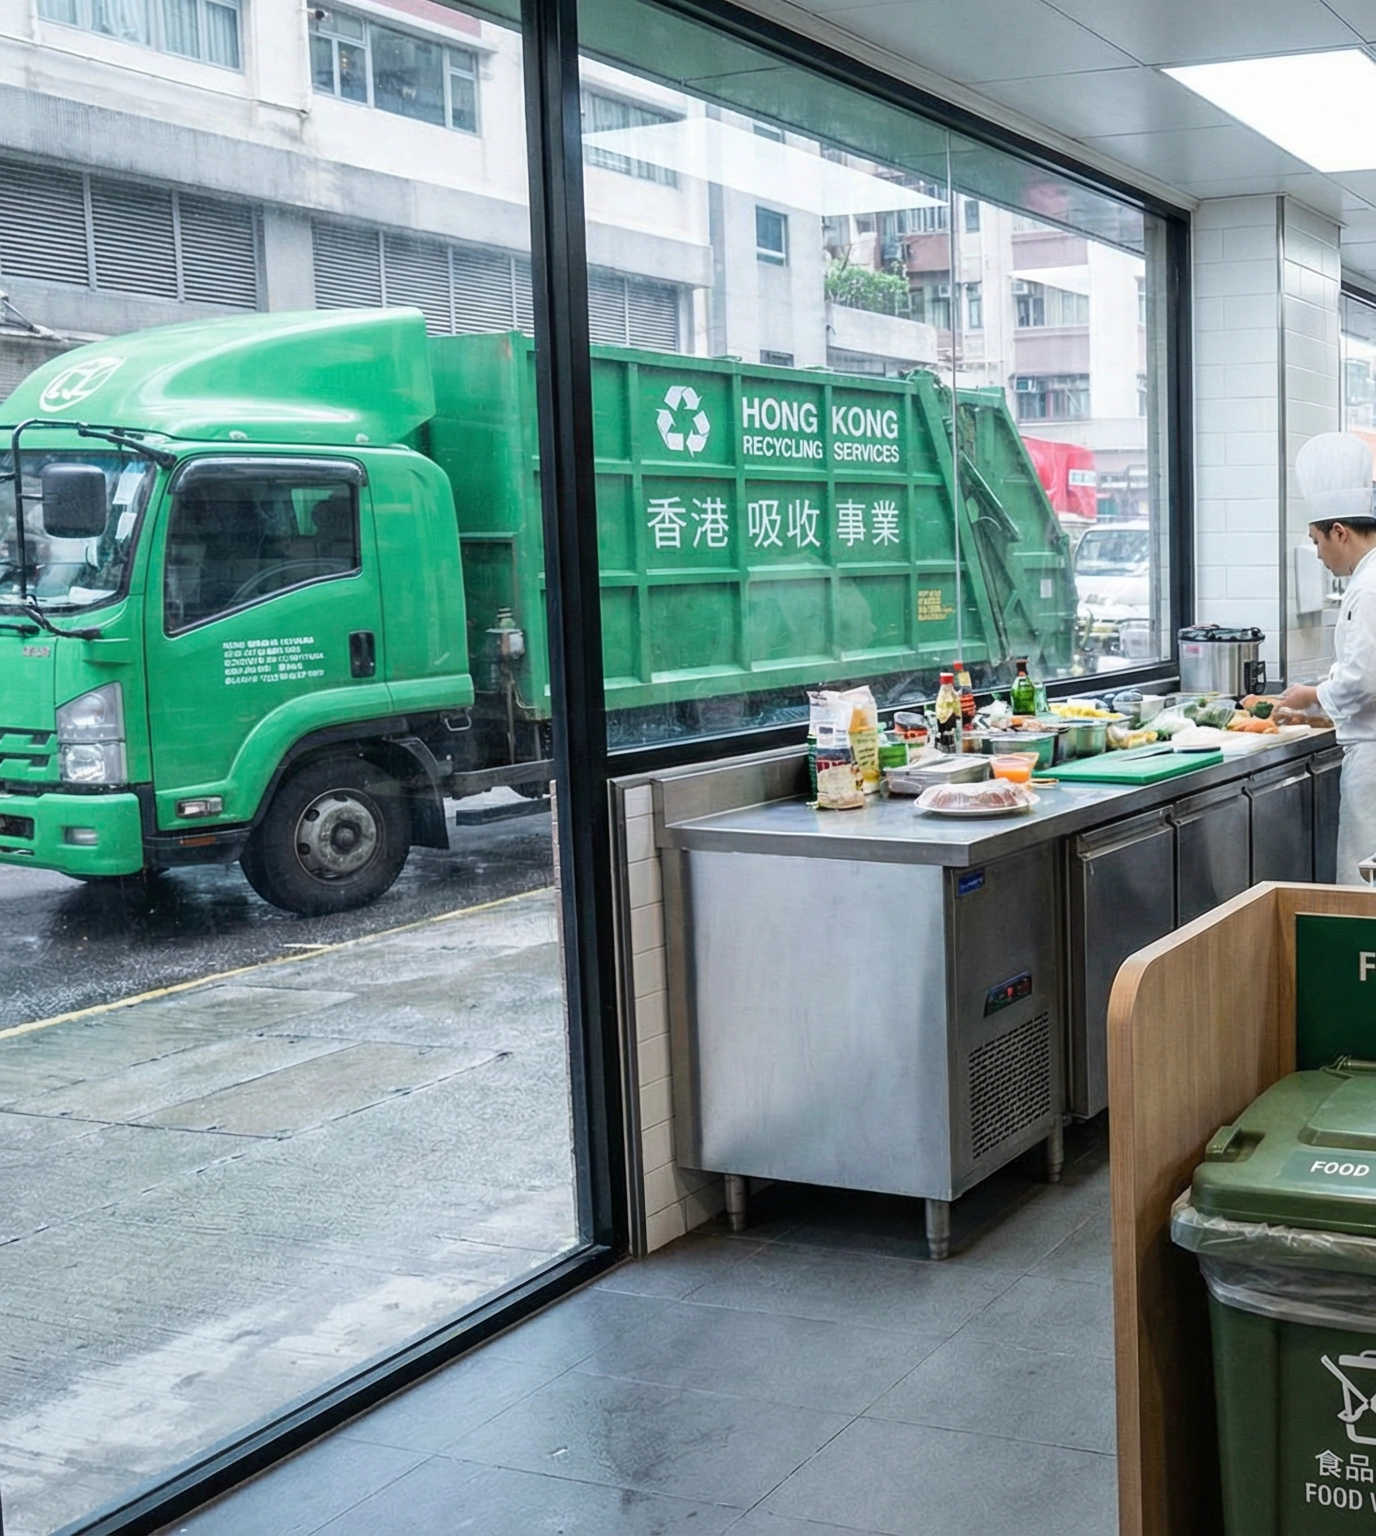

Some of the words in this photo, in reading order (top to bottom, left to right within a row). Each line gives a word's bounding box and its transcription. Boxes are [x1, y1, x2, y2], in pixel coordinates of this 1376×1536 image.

[741, 397, 818, 434] HONG
[832, 406, 898, 439] KONG
[743, 436, 823, 459] RECYCLING
[834, 443, 899, 463] SERVICES
[647, 497, 729, 549] 香港
[747, 499, 820, 548] 吸收
[835, 499, 899, 546] 事業
[1310, 1160, 1370, 1177] FOOD
[1305, 1483, 1363, 1511] FOOD
